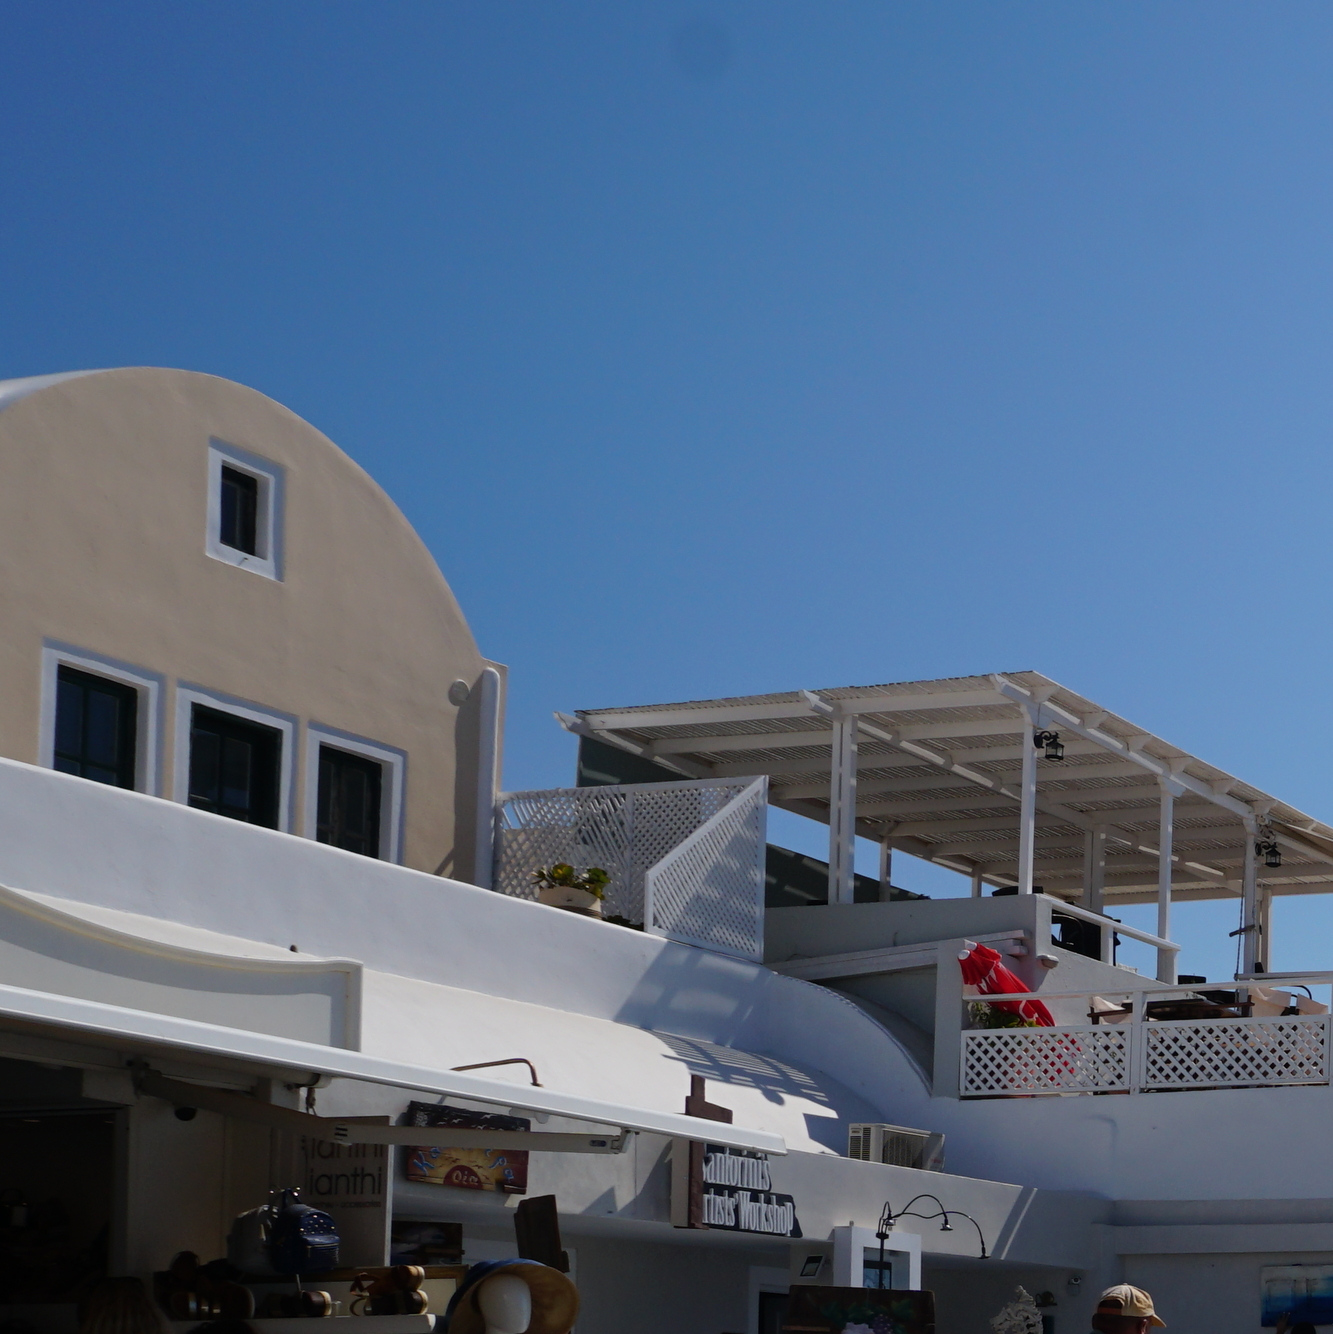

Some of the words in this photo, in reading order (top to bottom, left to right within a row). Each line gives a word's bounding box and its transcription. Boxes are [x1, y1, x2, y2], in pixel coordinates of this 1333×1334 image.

[309, 1167, 382, 1196] ianthi
[702, 1147, 771, 1191] antorini's
[702, 1188, 738, 1227] rtists'
[737, 1190, 794, 1237] Workshop
